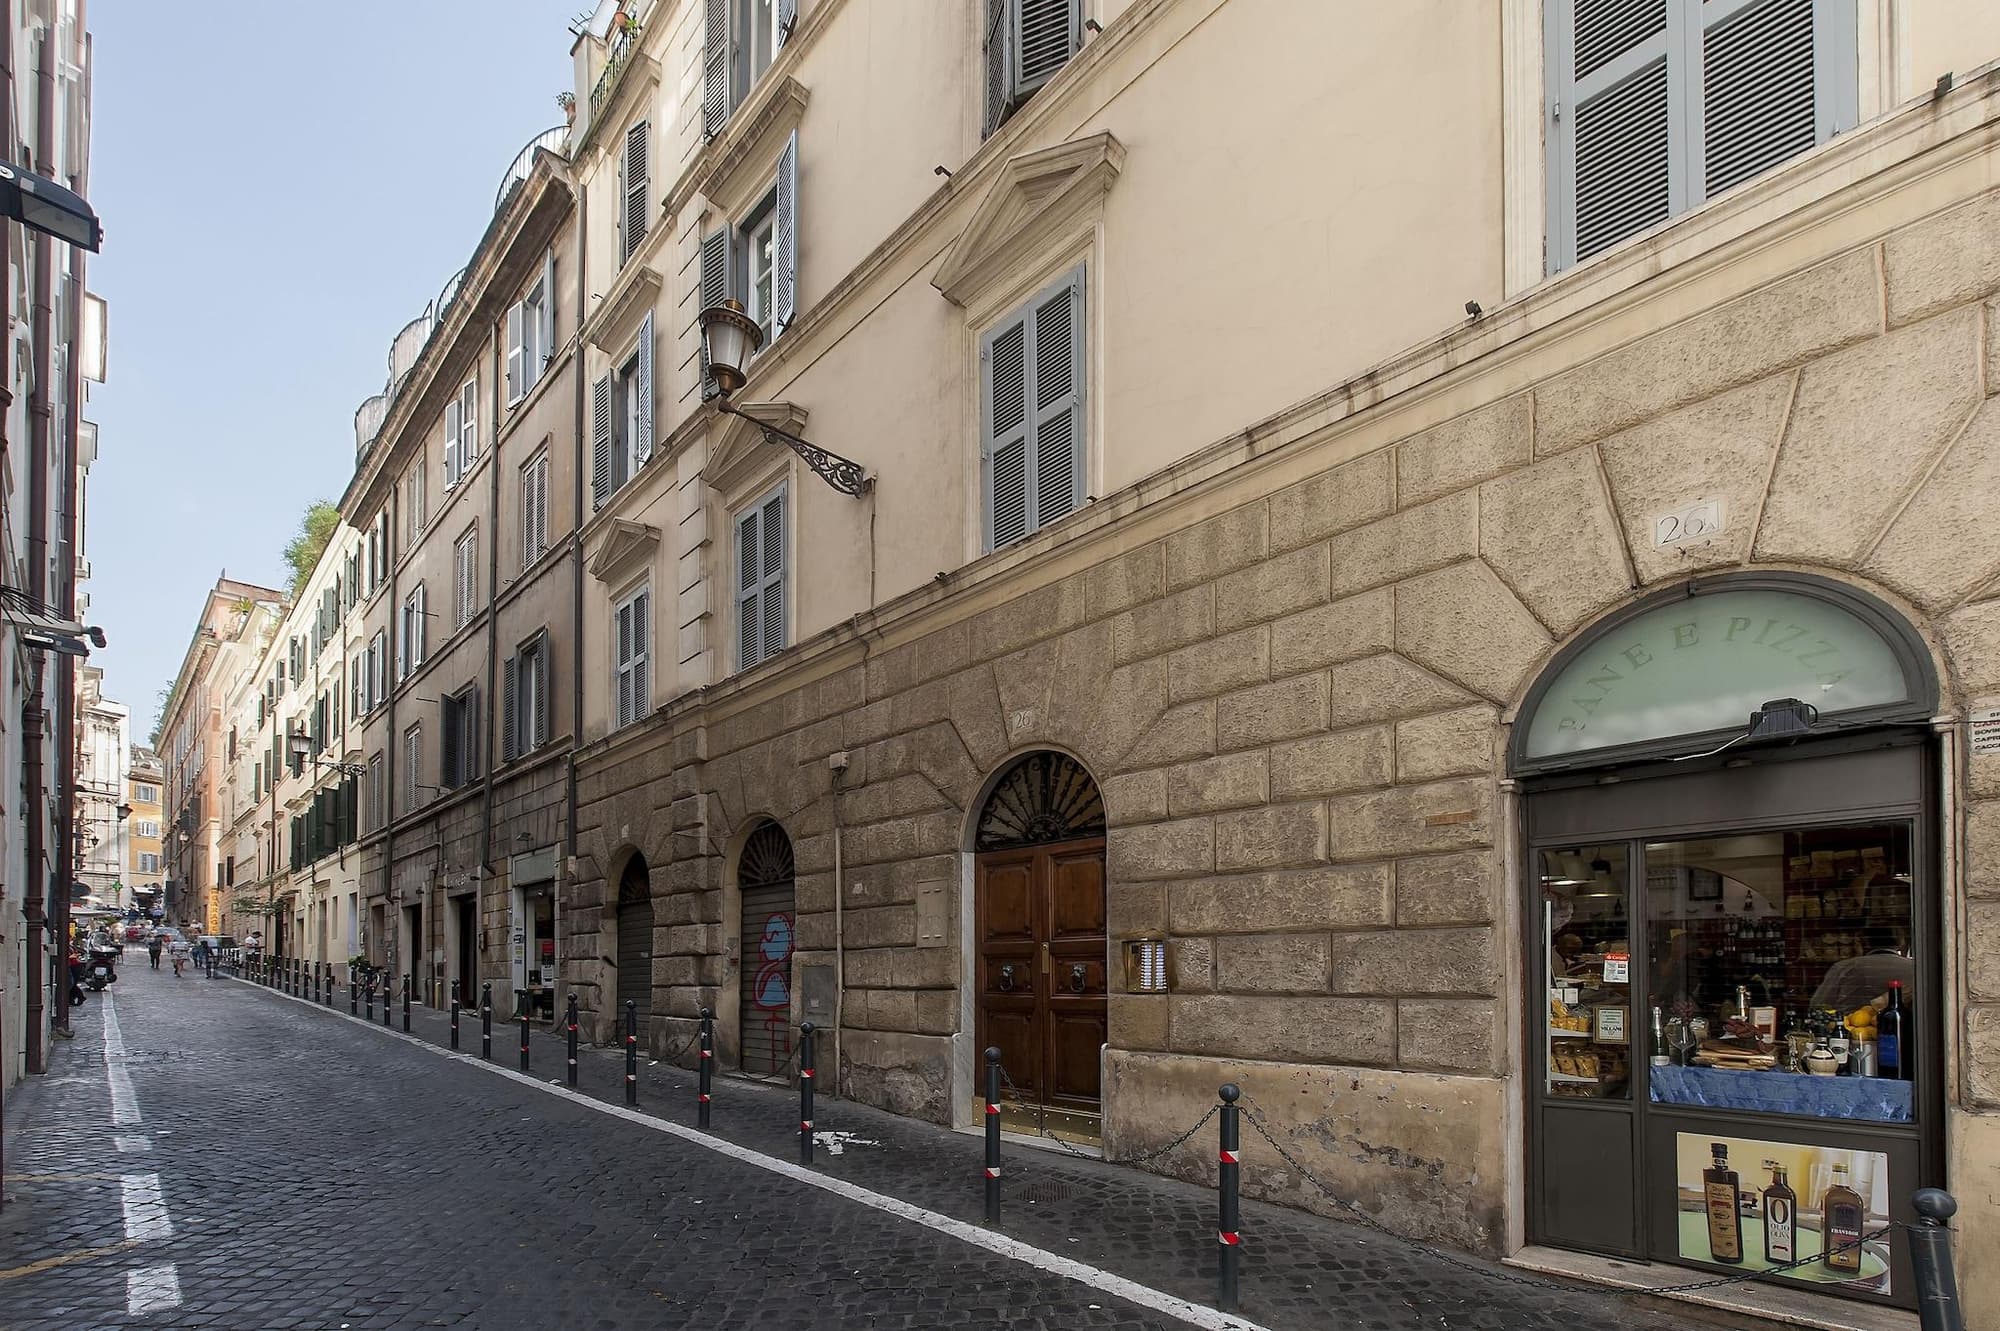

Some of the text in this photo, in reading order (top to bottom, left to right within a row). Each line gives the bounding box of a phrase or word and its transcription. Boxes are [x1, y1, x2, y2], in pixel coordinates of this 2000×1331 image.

[1558, 616, 1857, 733] PANE E PIZZA
